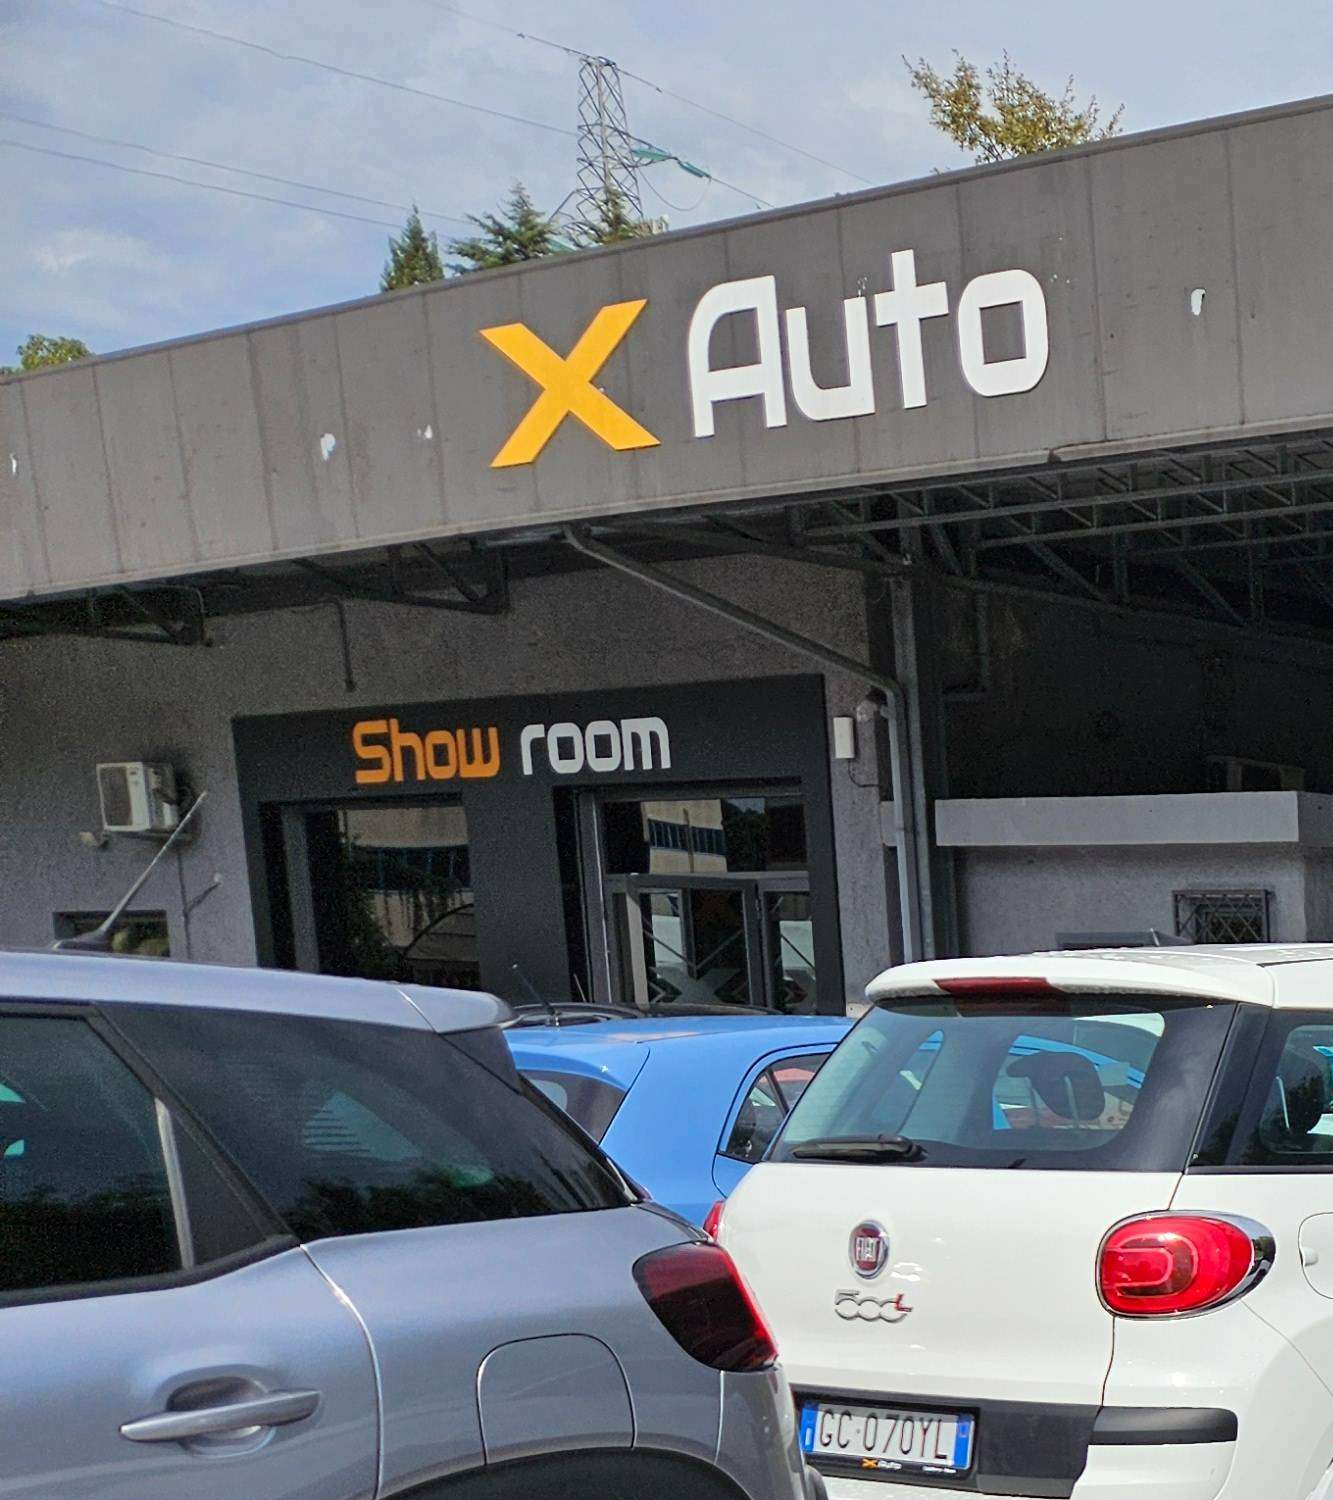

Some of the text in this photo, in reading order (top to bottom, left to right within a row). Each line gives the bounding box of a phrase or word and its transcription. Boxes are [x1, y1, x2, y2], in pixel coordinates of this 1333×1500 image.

[479, 248, 1050, 468] X Auto
[352, 716, 672, 784] Show room
[834, 1289, 913, 1324] 500L
